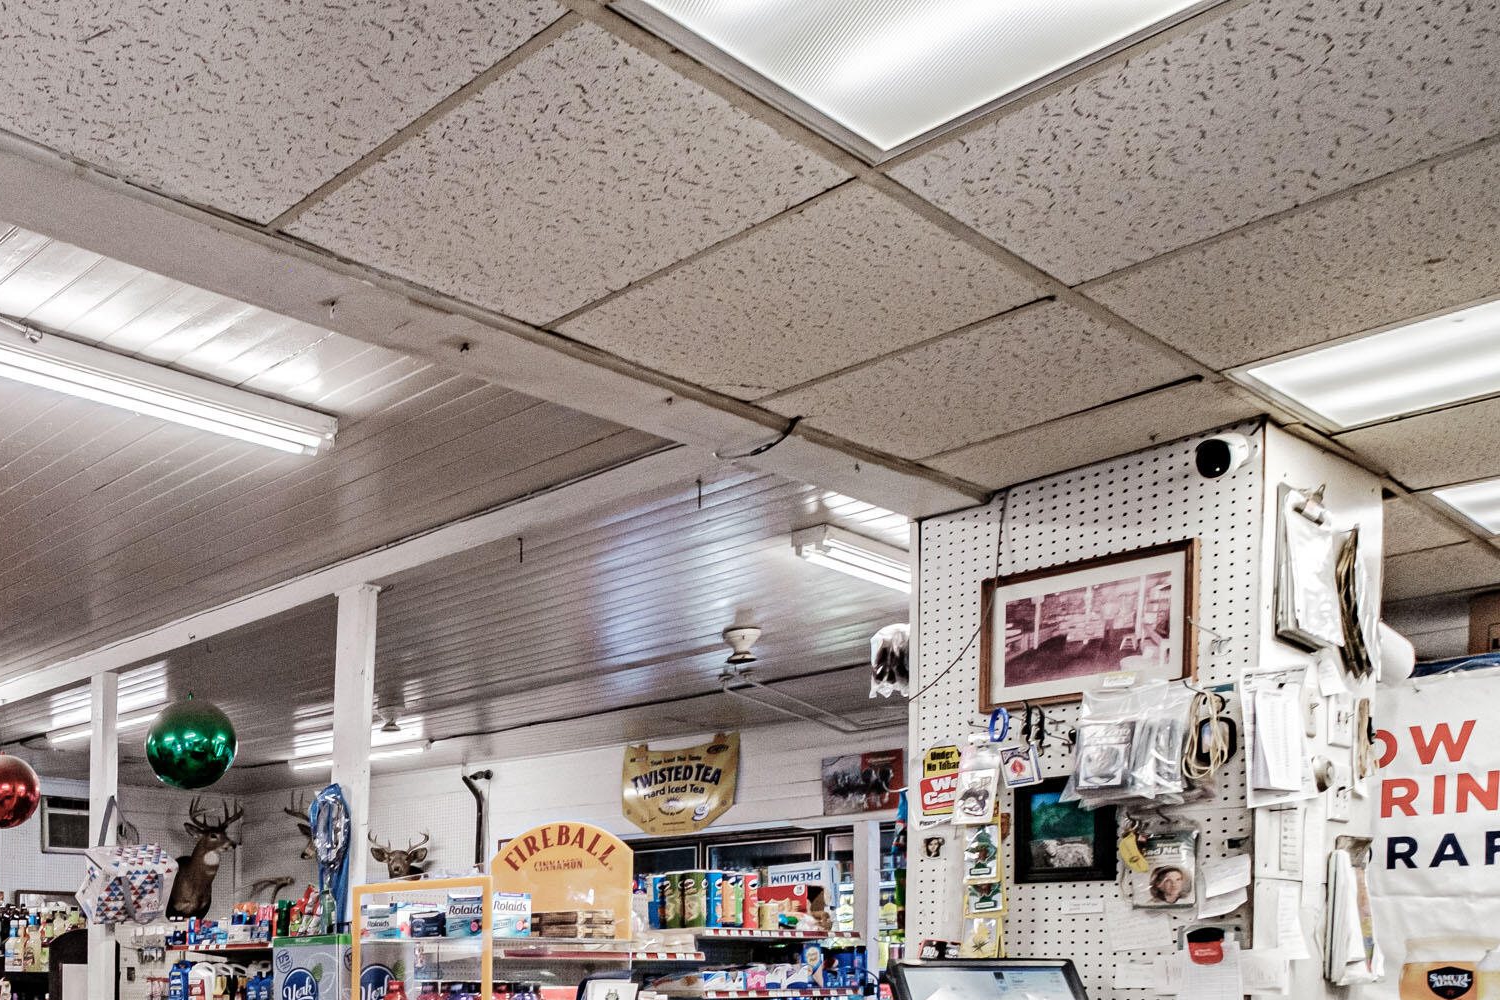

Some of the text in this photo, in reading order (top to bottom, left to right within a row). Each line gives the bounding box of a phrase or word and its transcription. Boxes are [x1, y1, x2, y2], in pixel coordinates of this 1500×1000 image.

[630, 763, 722, 789] TWISTED TEA
[667, 784, 687, 794] Iced
[689, 784, 705, 794] Tea
[503, 824, 617, 872] FIREBALL
[770, 871, 822, 885] PREMIUM
[448, 904, 483, 915] Rolaids
[493, 900, 527, 912] Rolaids
[1429, 973, 1469, 982] SAMUEL
[1431, 979, 1469, 988] ADAMS
